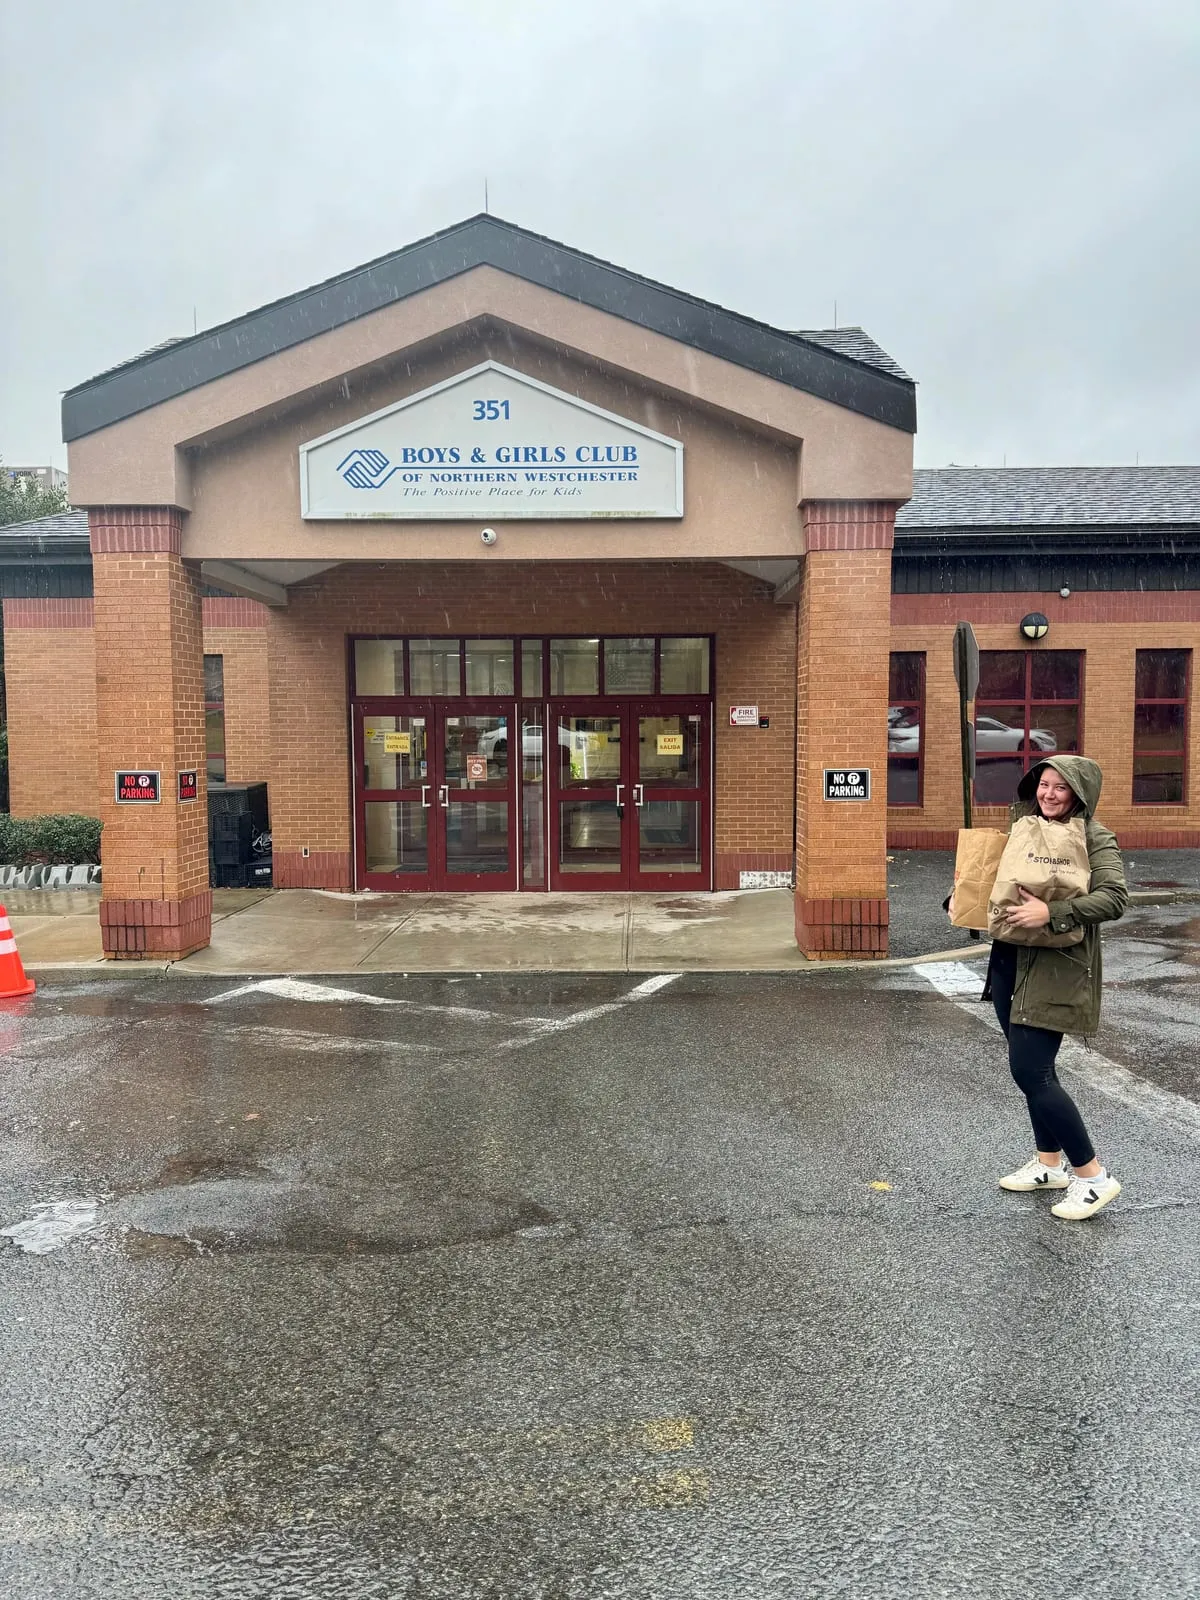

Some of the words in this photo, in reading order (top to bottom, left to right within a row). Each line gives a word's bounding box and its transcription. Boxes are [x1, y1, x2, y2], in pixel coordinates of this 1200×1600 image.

[473, 400, 509, 420] 351
[401, 447, 460, 463] BOYS
[470, 447, 486, 463] &
[495, 446, 566, 463] GIRLS
[576, 446, 637, 462] CLUB
[402, 473, 422, 482] OF
[430, 473, 517, 482] NORTHERN
[525, 472, 638, 481] WESTCHESTER
[402, 488, 426, 496] The
[433, 487, 482, 496] Positive
[489, 487, 523, 496] Place
[529, 487, 547, 497] for
[554, 487, 582, 496] Kids
[124, 775, 136, 786] NO
[833, 773, 845, 785] NO
[120, 788, 155, 799] PARKING
[829, 785, 865, 797] PARKING
